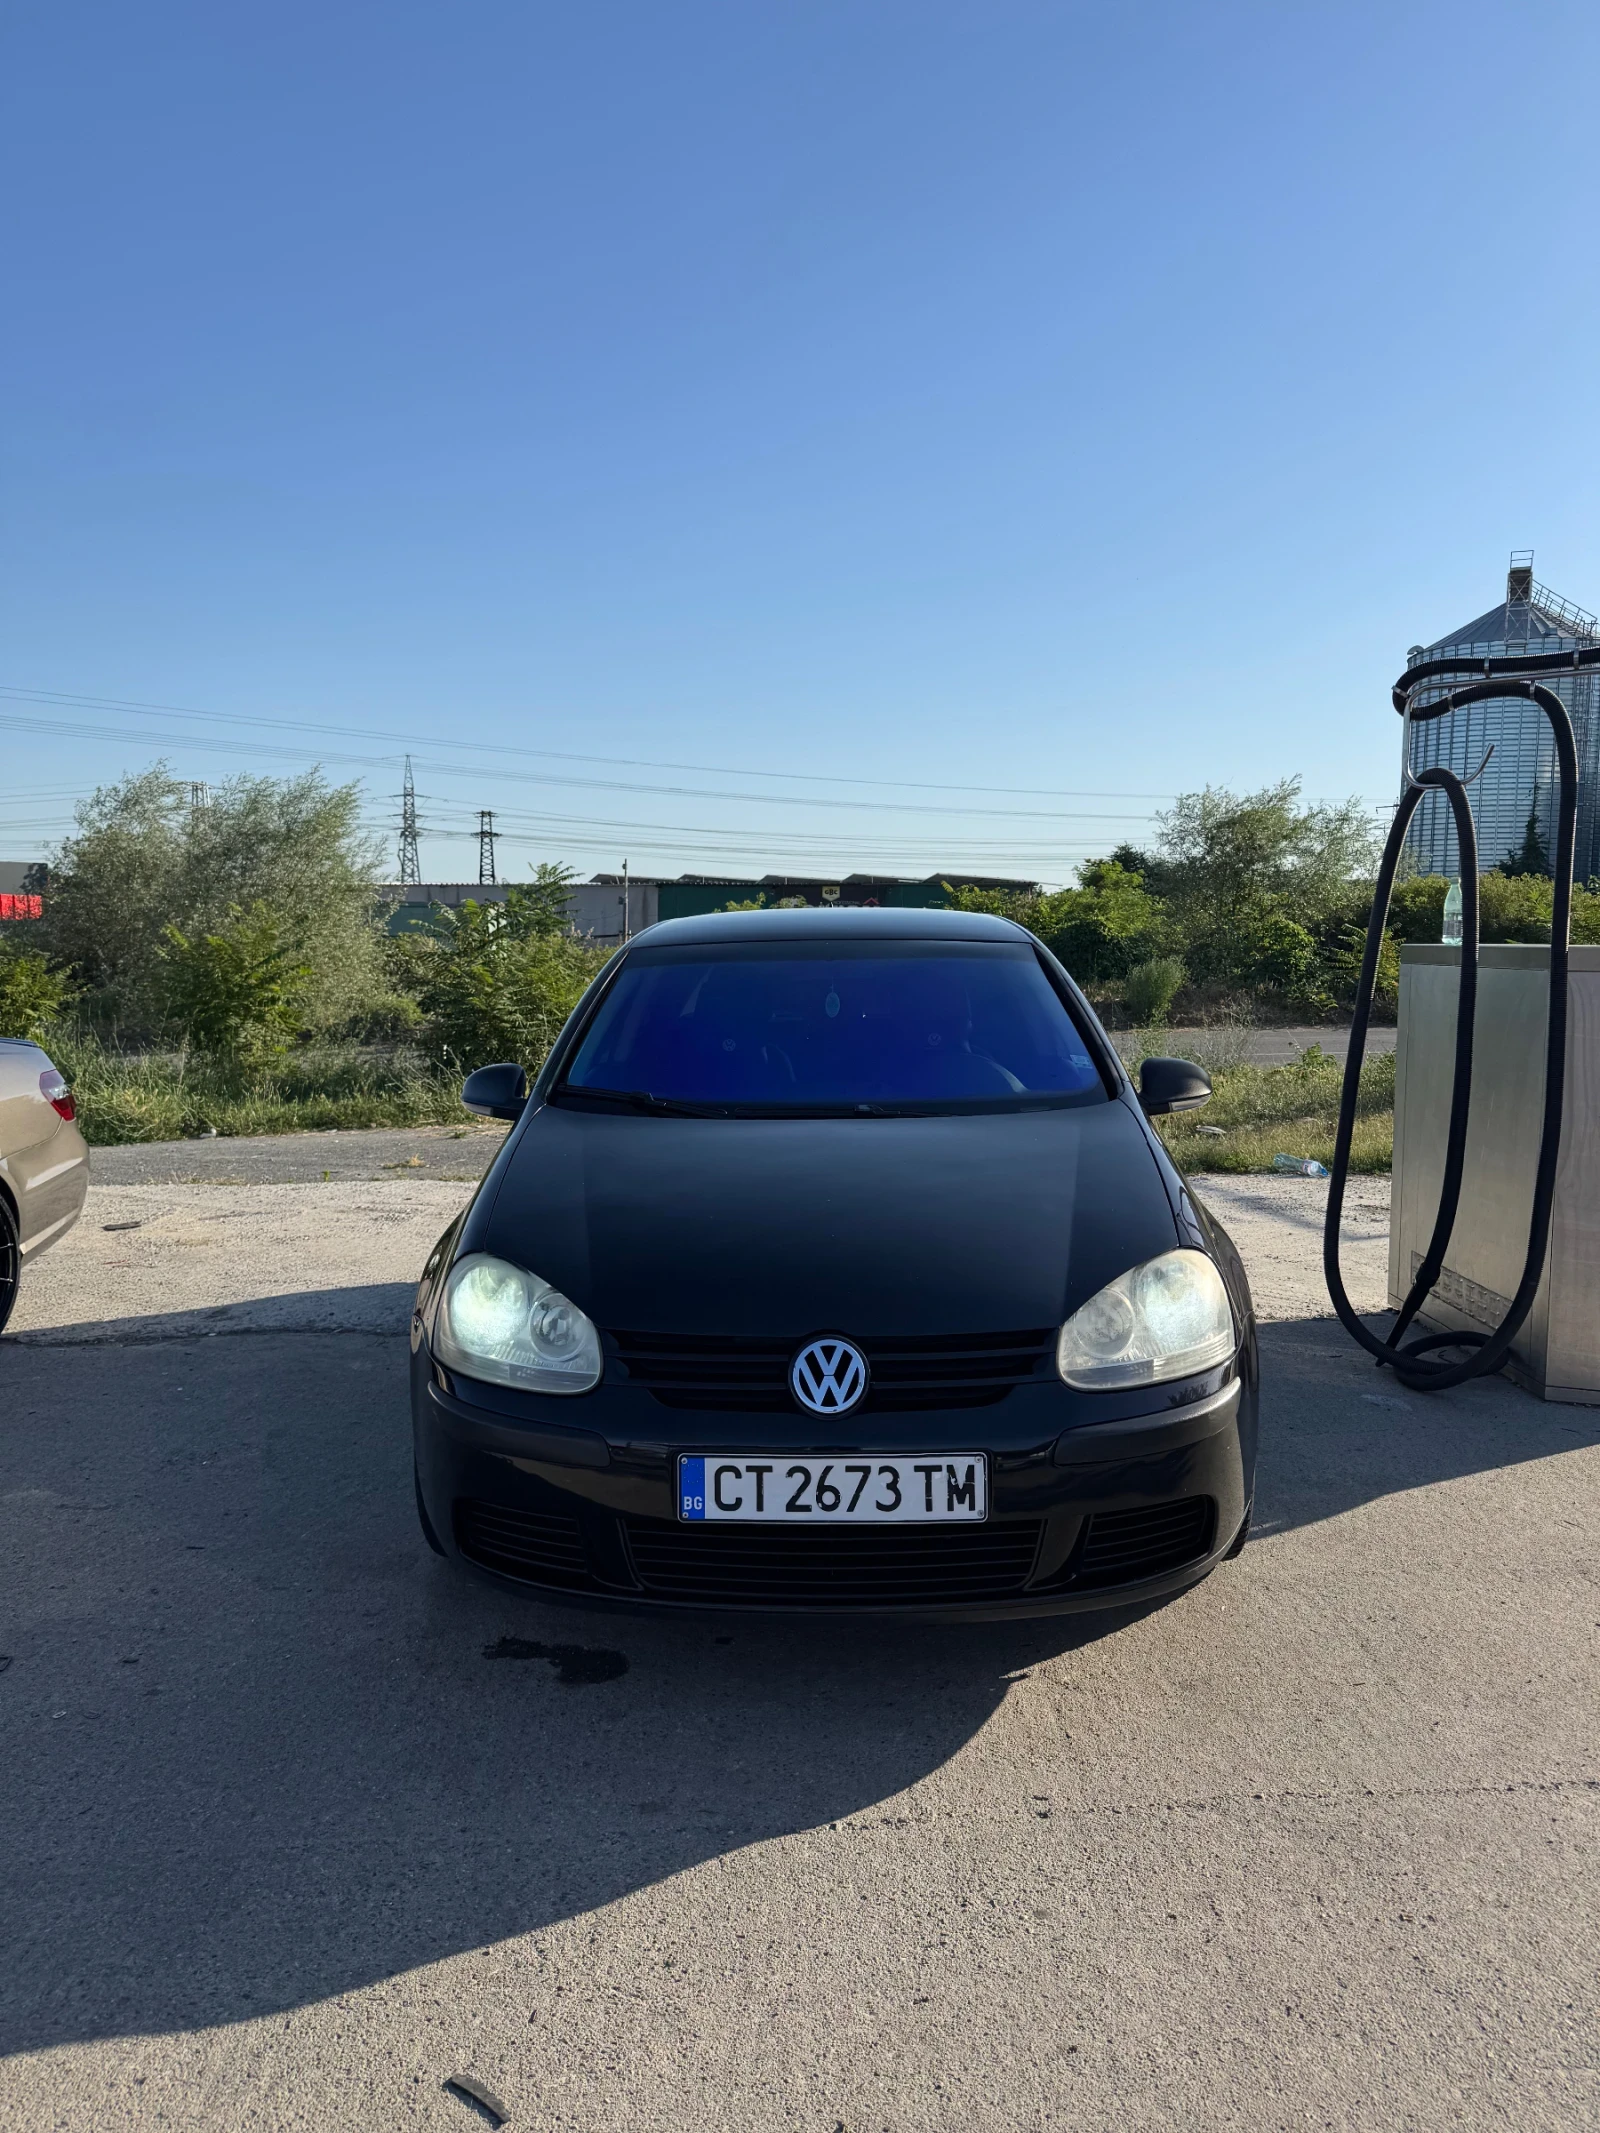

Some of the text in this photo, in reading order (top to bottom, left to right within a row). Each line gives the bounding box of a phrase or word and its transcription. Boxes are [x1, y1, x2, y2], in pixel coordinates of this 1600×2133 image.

[683, 1496, 703, 1510] BG
[714, 1464, 976, 1512] CT 2673 TM
